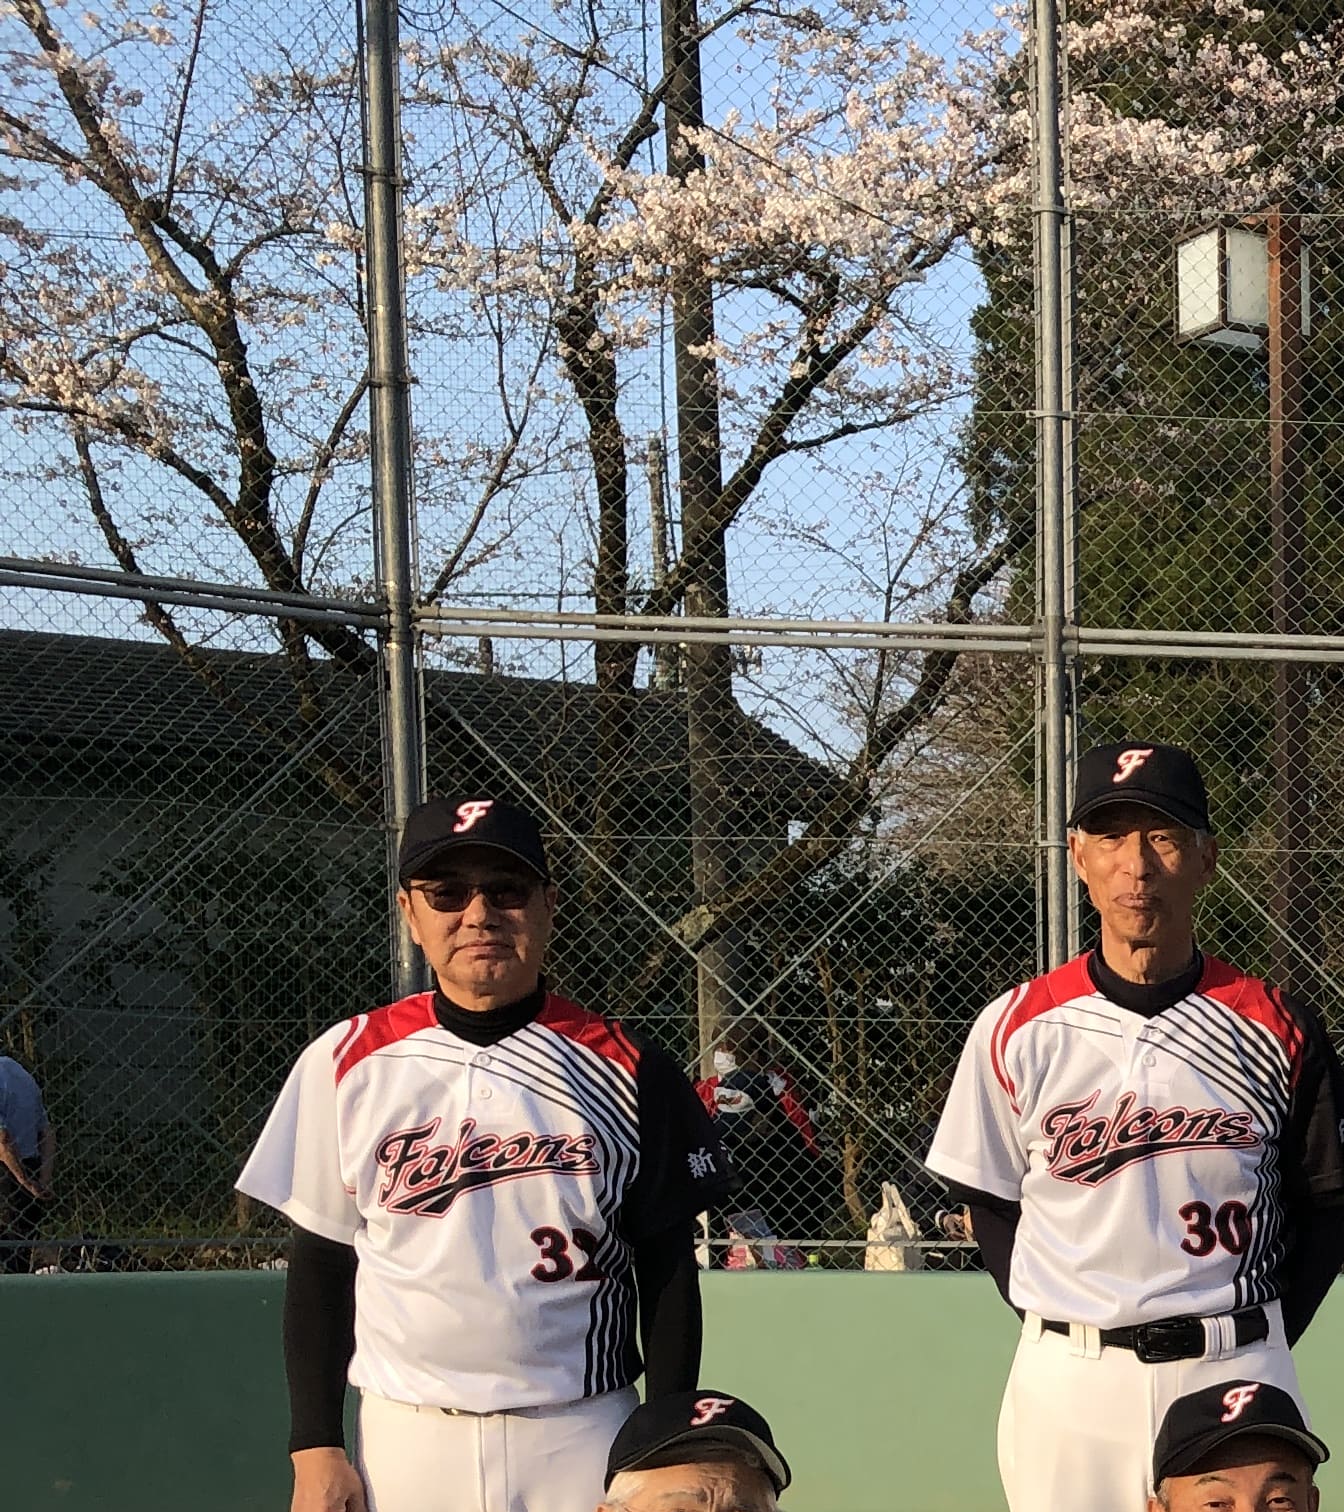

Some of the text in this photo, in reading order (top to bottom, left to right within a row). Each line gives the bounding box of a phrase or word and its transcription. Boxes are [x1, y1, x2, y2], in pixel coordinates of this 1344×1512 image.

[1112, 747, 1154, 783] F
[453, 800, 494, 833] F
[1041, 1089, 1264, 1188] Falcons
[375, 1117, 600, 1219] Falcons
[1179, 1200, 1252, 1257] 30
[690, 1397, 734, 1427] F
[1220, 1384, 1260, 1423] F
